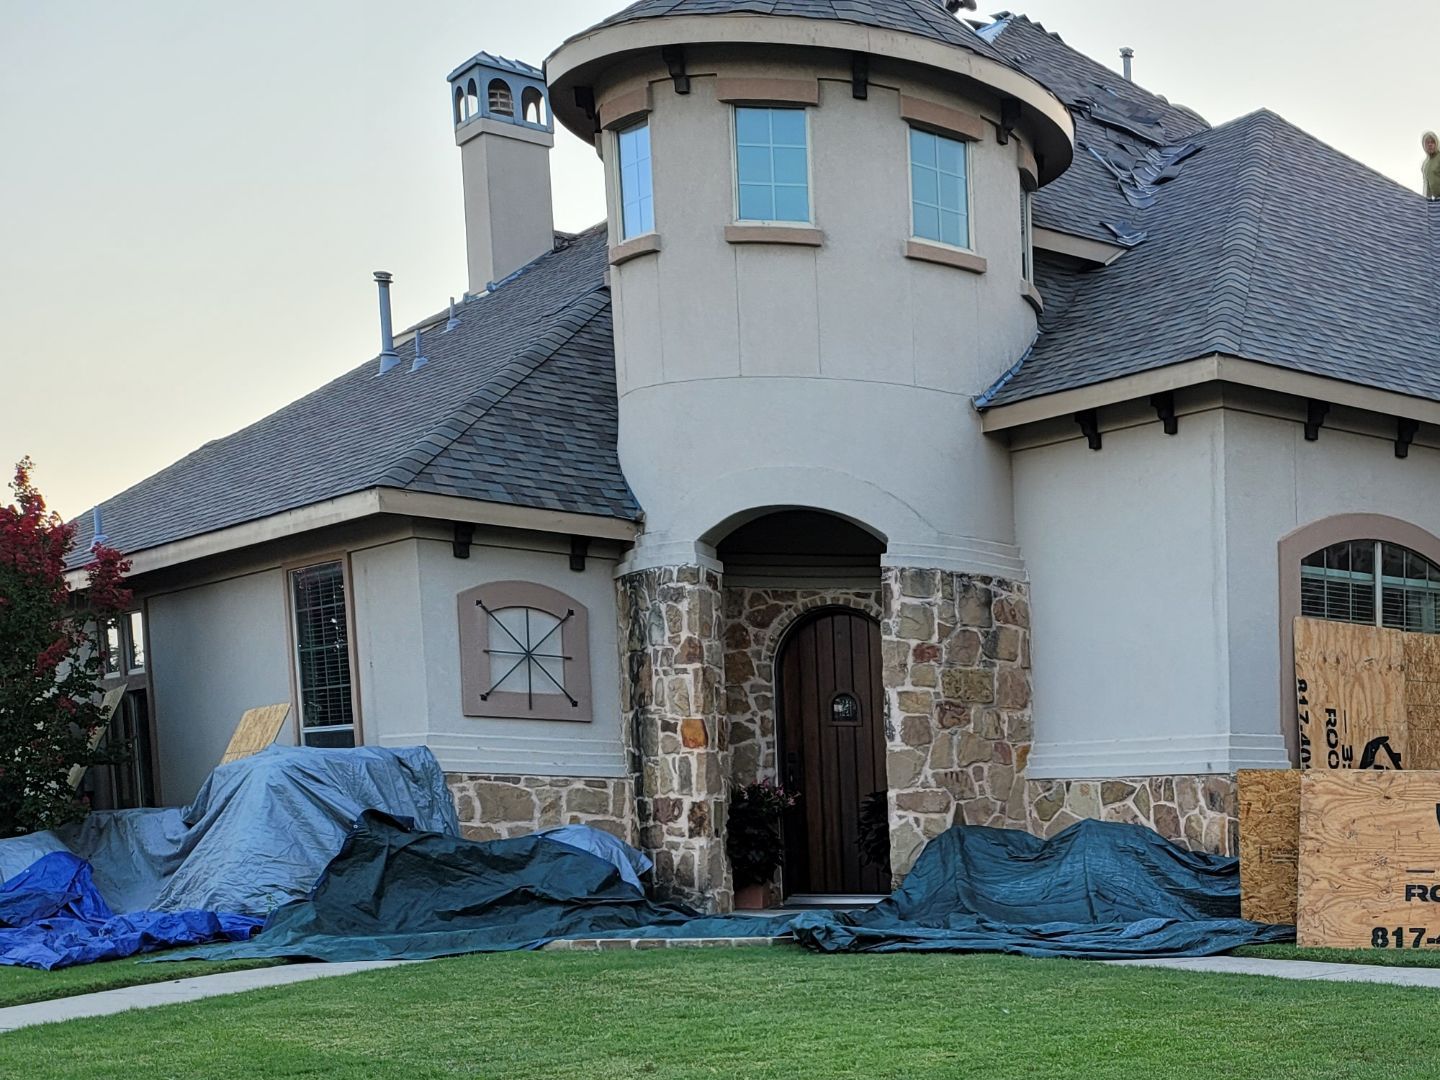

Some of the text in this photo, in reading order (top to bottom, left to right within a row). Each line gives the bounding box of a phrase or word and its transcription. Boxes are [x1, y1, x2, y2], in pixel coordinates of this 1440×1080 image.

[1298, 678, 1311, 769] 817-40
[1325, 708, 1340, 769] ROO
[1342, 745, 1353, 769] 3:
